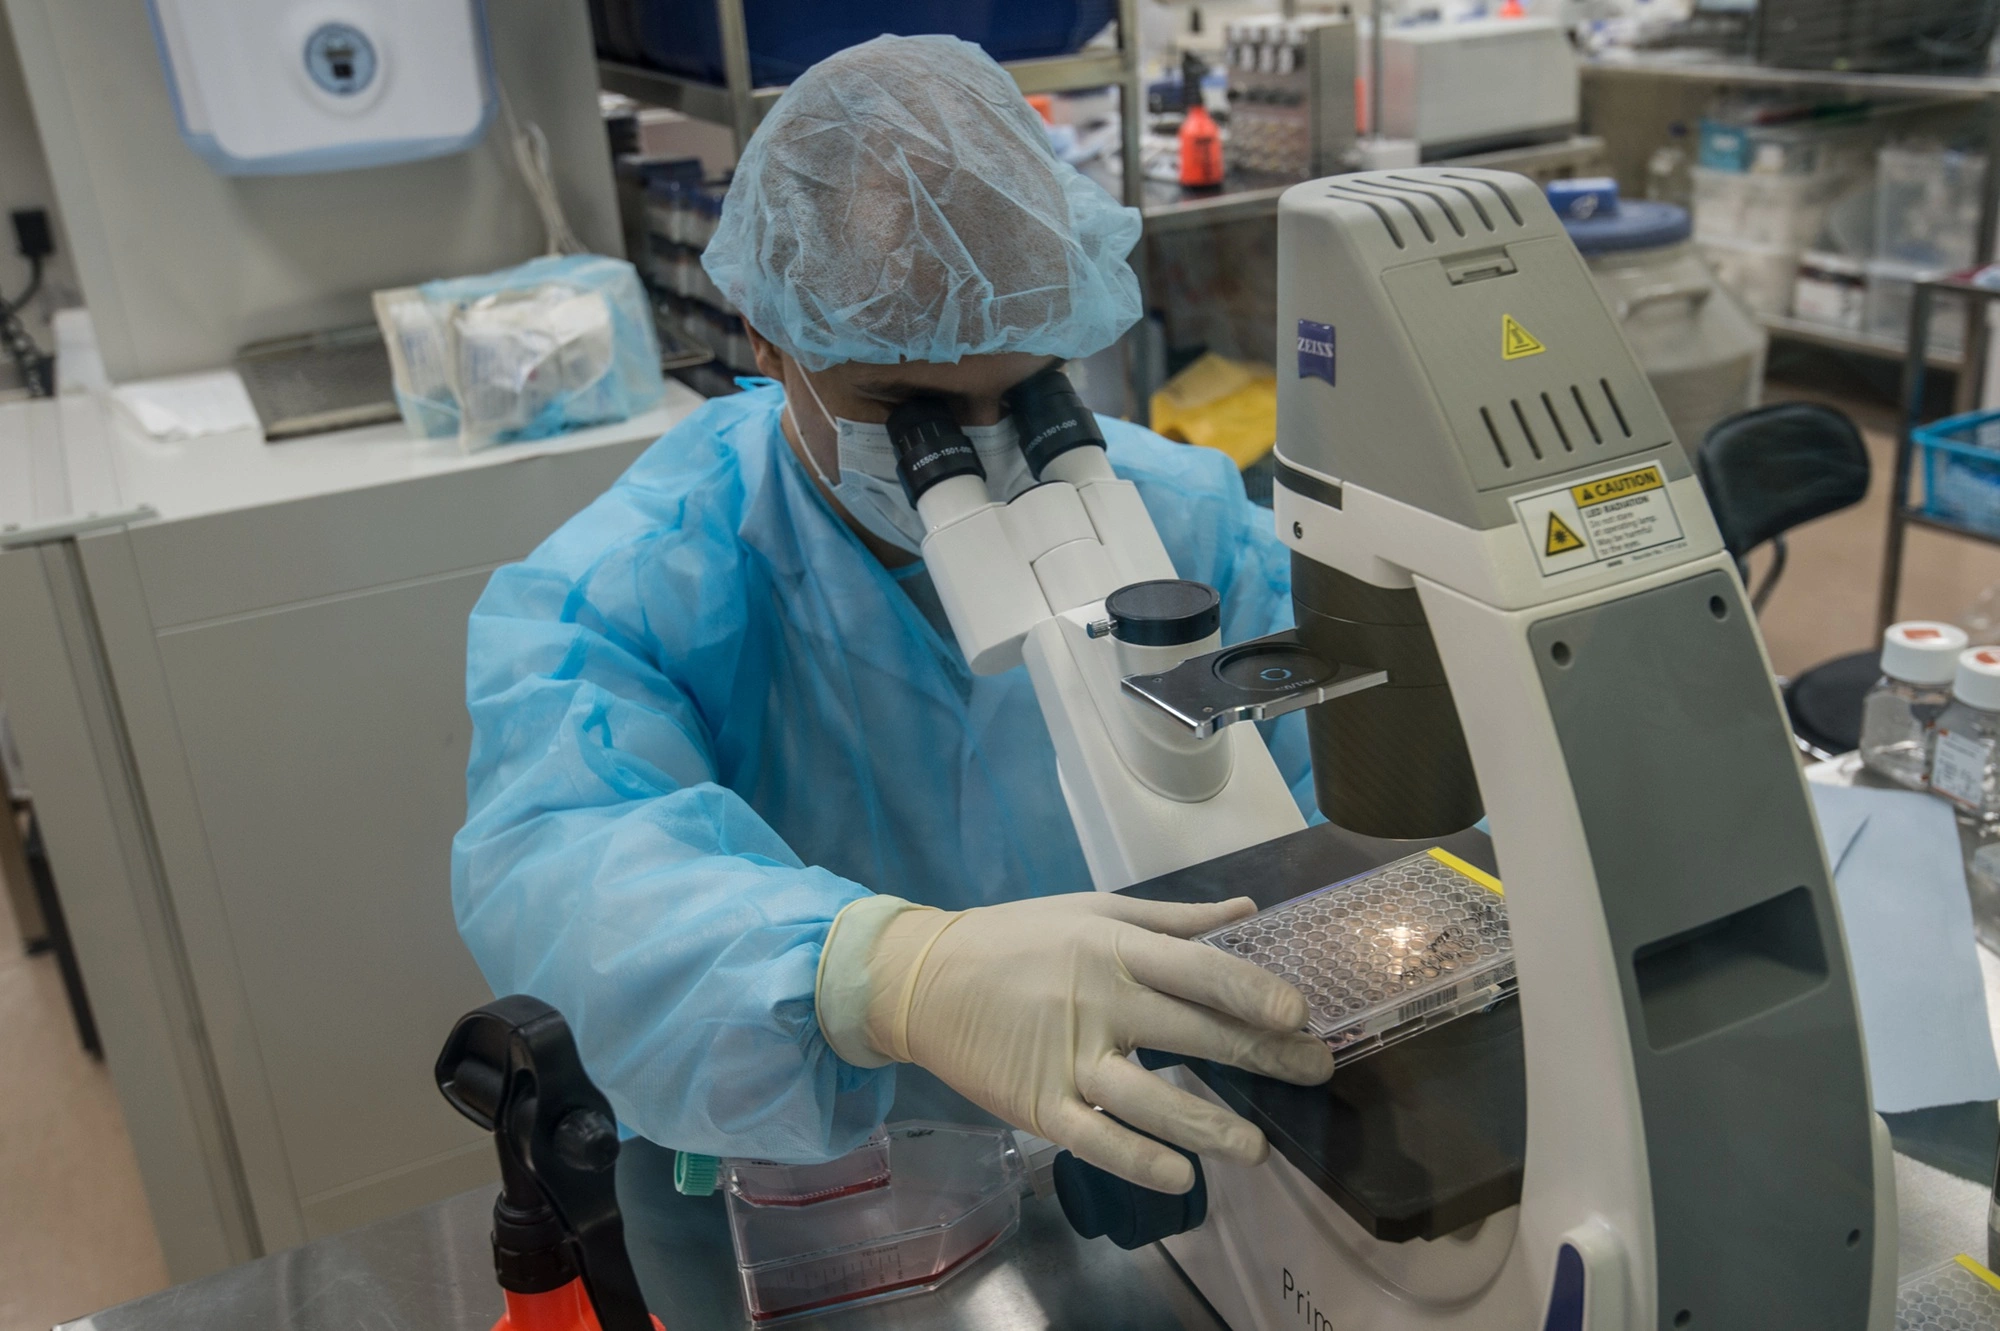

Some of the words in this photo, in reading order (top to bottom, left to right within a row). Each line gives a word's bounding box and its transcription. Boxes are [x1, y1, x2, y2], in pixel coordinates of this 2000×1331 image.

[1298, 337, 1334, 358] ZEISS
[1595, 472, 1656, 496] CAUTION
[1585, 507, 1602, 518] LED
[1604, 496, 1649, 512] RADIATION
